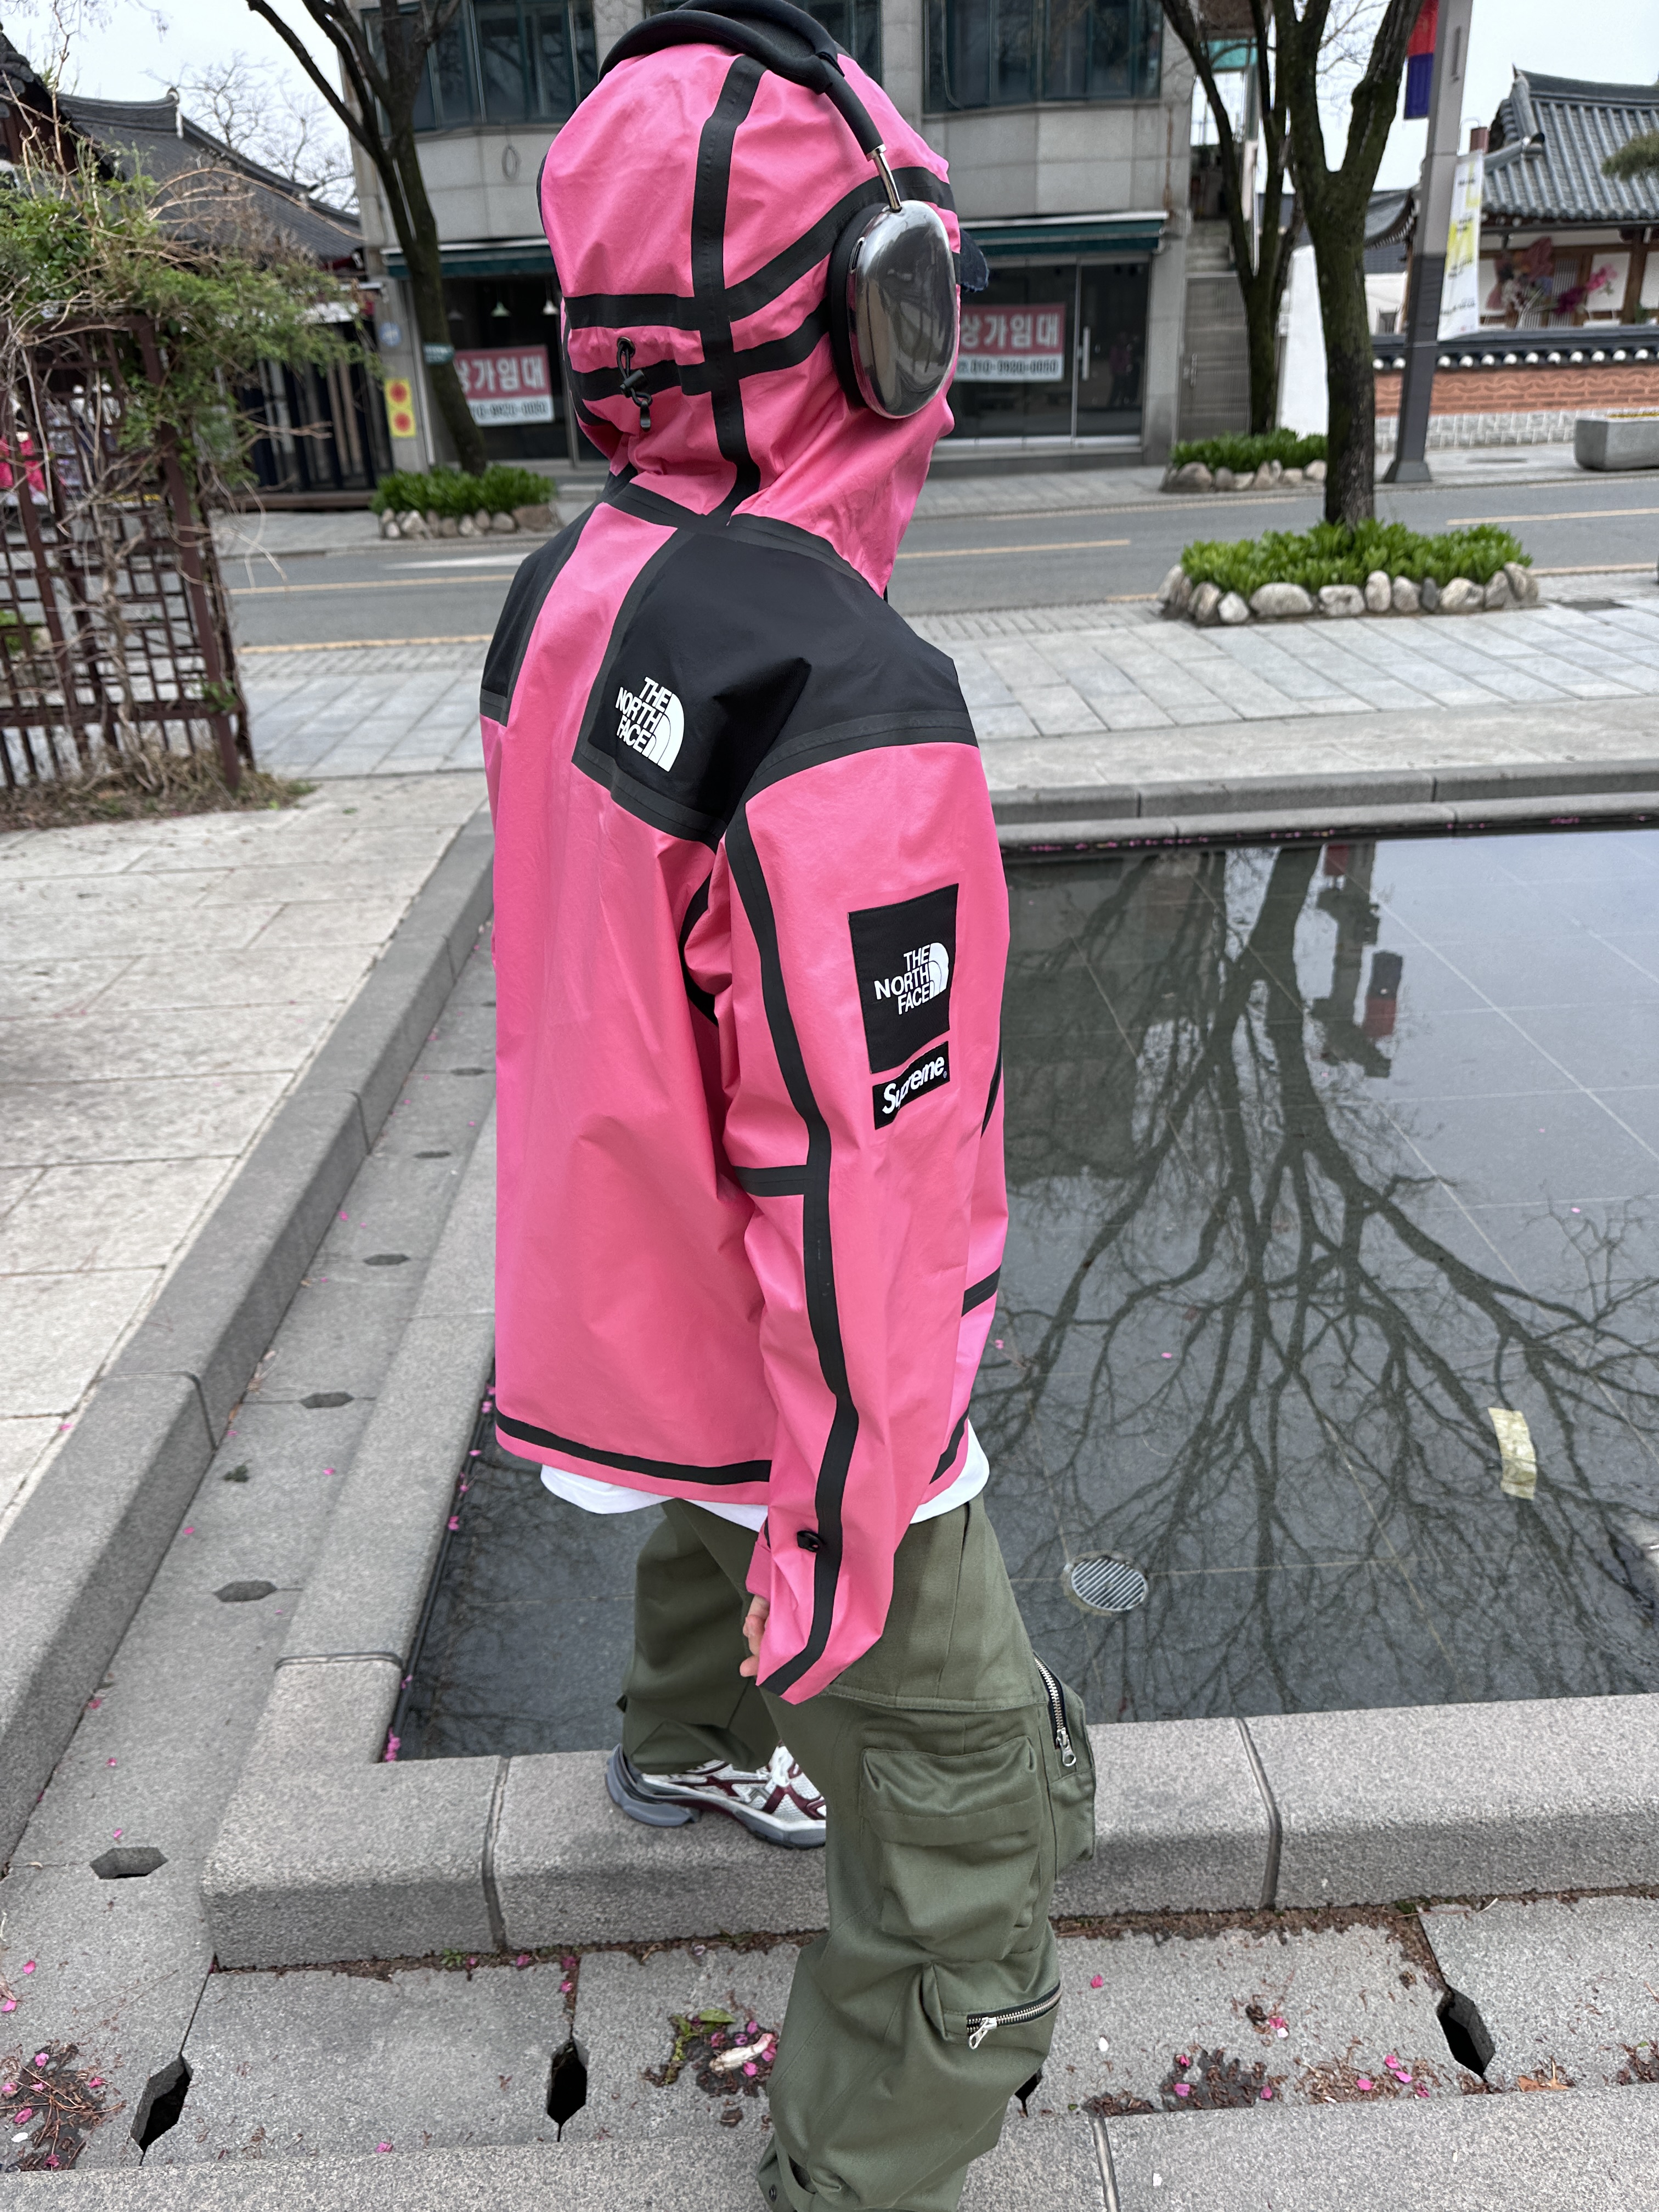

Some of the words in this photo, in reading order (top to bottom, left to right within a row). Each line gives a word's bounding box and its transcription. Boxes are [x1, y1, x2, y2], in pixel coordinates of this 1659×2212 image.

[961, 313, 1060, 349] 상가임대
[615, 687, 663, 733] NORTH
[639, 676, 672, 713] THE
[616, 714, 652, 753] FACE
[904, 944, 930, 972] THE
[874, 963, 929, 1000] NORTH
[898, 987, 930, 1015] FACE
[882, 1056, 945, 1114] Supreme
